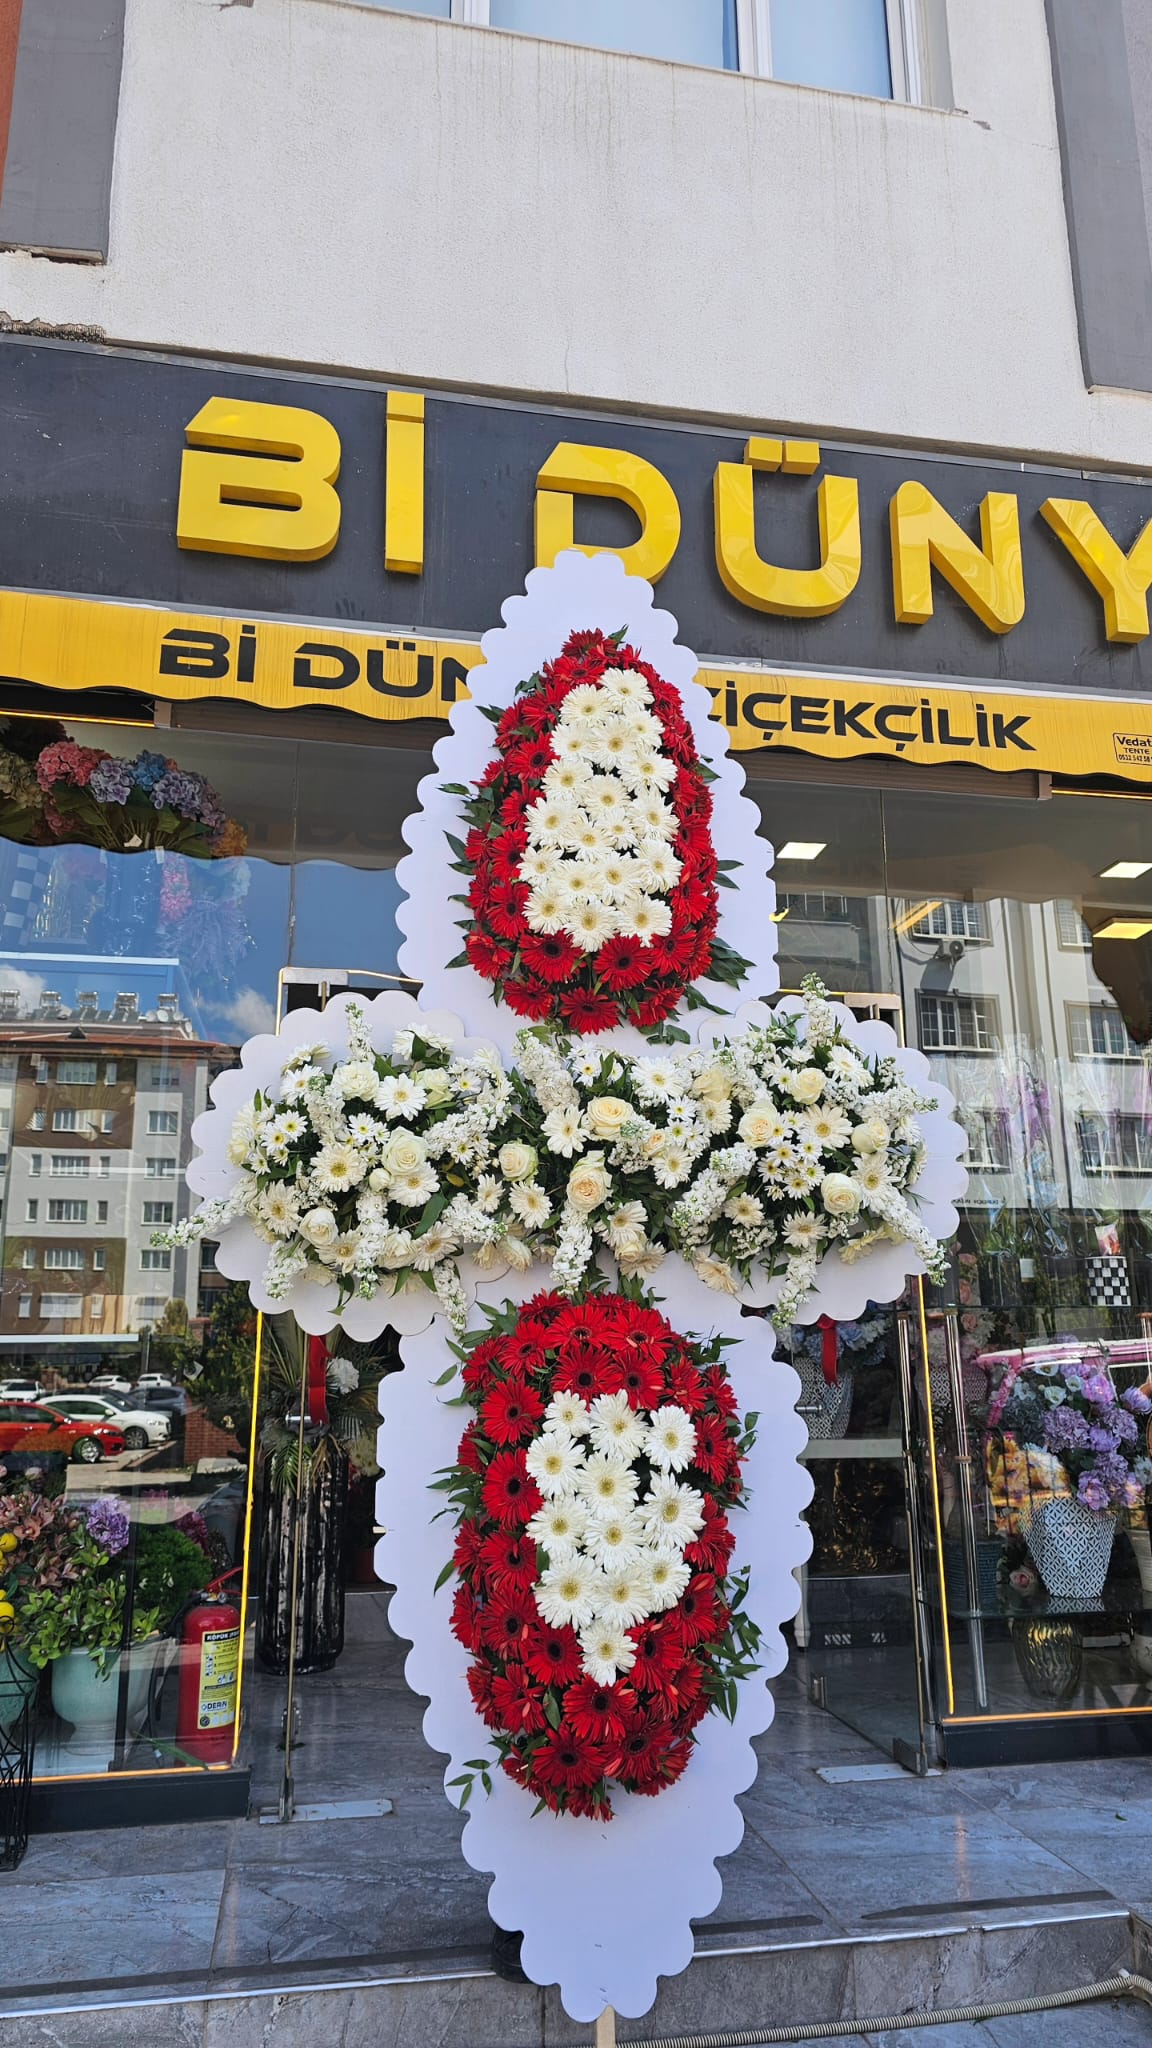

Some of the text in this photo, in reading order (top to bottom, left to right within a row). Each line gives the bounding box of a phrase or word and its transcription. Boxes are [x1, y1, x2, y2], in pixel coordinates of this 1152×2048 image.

[177, 390, 1152, 644] Bİ DÜNY
[159, 624, 258, 683] Bİ
[1116, 735, 1152, 748] Vedat
